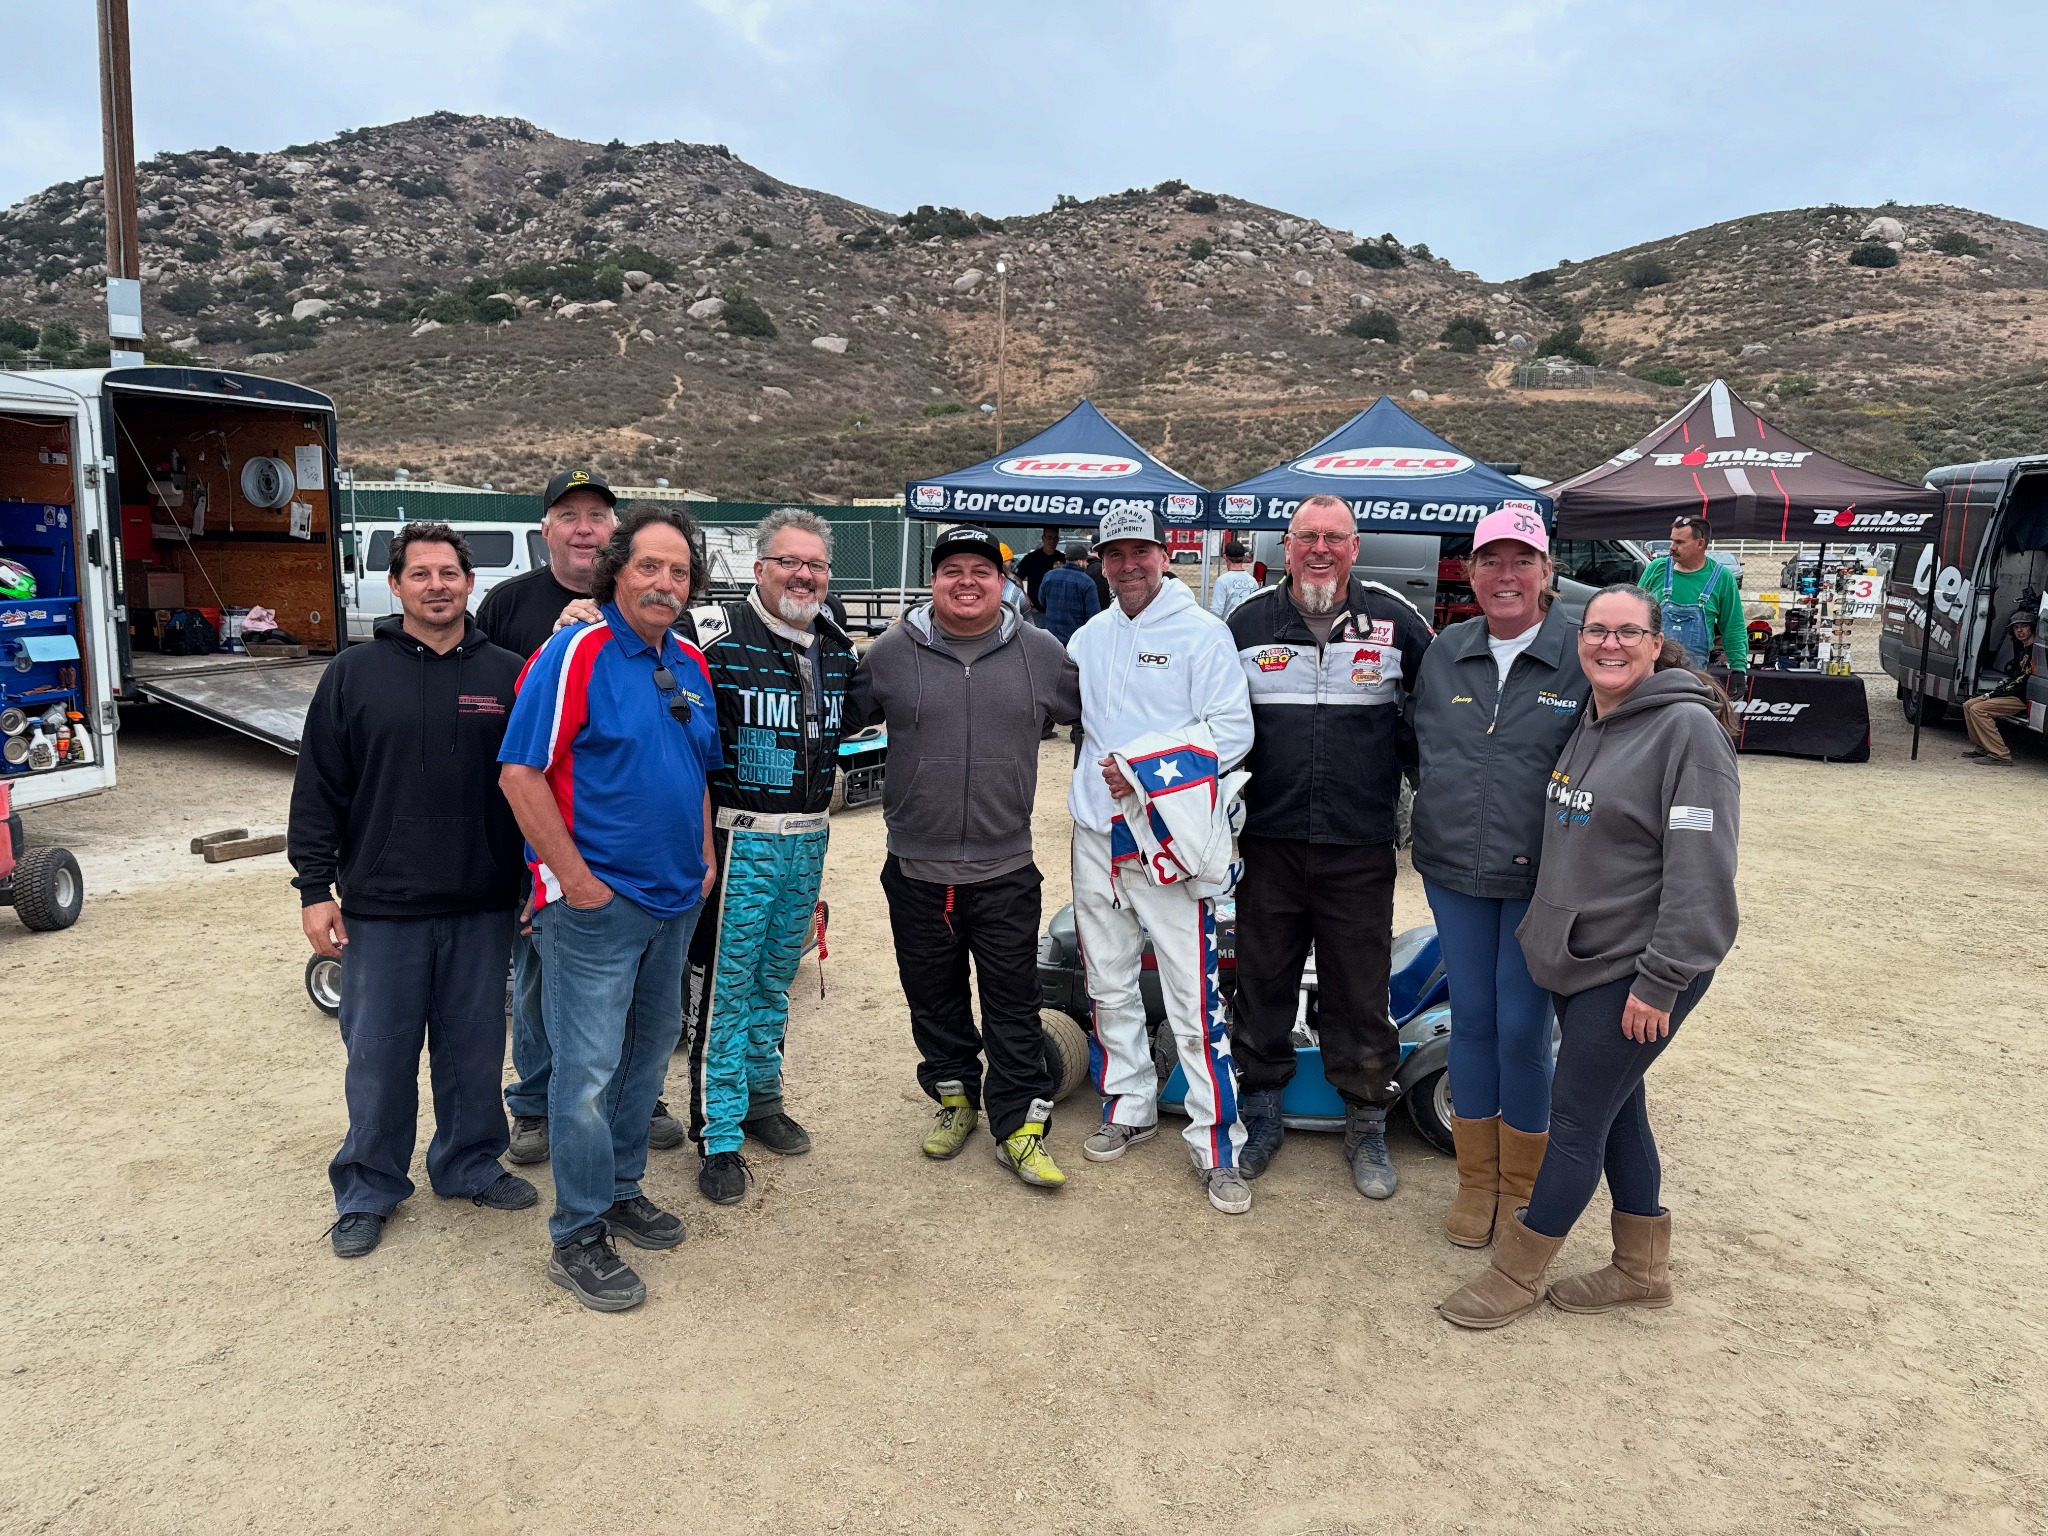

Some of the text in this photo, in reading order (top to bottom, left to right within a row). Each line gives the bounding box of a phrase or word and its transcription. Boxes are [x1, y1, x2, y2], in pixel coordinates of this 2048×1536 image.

[919, 487, 942, 497] TORCO
[1170, 495, 1195, 506] TORCO
[1228, 496, 1253, 506] TORCO
[954, 489, 1154, 515] torcousa.com
[1268, 498, 1488, 522] tousa.com
[1813, 504, 1933, 527] Bomber
[1855, 581, 1873, 598] 3
[1138, 654, 1168, 665] KPD
[1258, 655, 1290, 665] NEO
[1537, 696, 1577, 708] MOWER
[738, 726, 777, 748] NEWS
[738, 746, 795, 768] POLITICS
[738, 764, 793, 786] CULTURE
[1547, 781, 1593, 812] OWER
